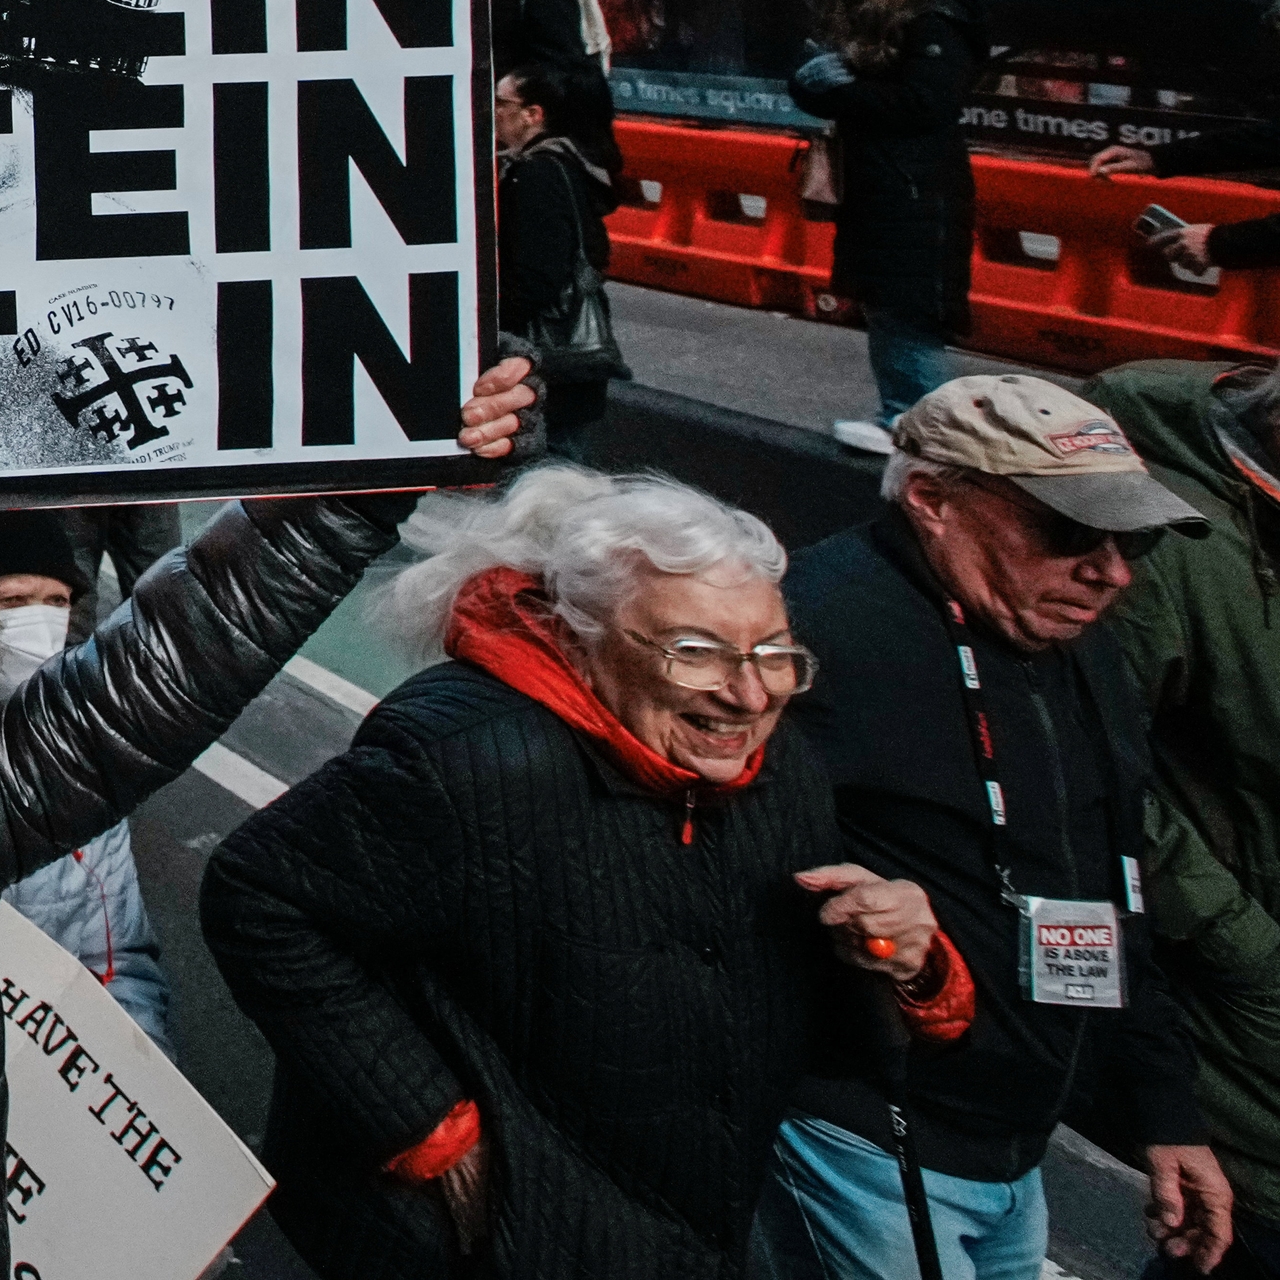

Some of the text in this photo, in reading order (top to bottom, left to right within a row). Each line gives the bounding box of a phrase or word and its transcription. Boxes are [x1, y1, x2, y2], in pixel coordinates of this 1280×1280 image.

[1015, 108, 1109, 140] times
[48, 283, 98, 304] CASE NUMBER
[13, 328, 41, 368] ED
[152, 443, 181, 459] TRUMP
[1040, 928, 1111, 945] NO ONE
[1044, 948, 1109, 962] IS ABOVE
[1045, 963, 1108, 978] THE LAW
[1, 977, 182, 1193] HAVE THE
